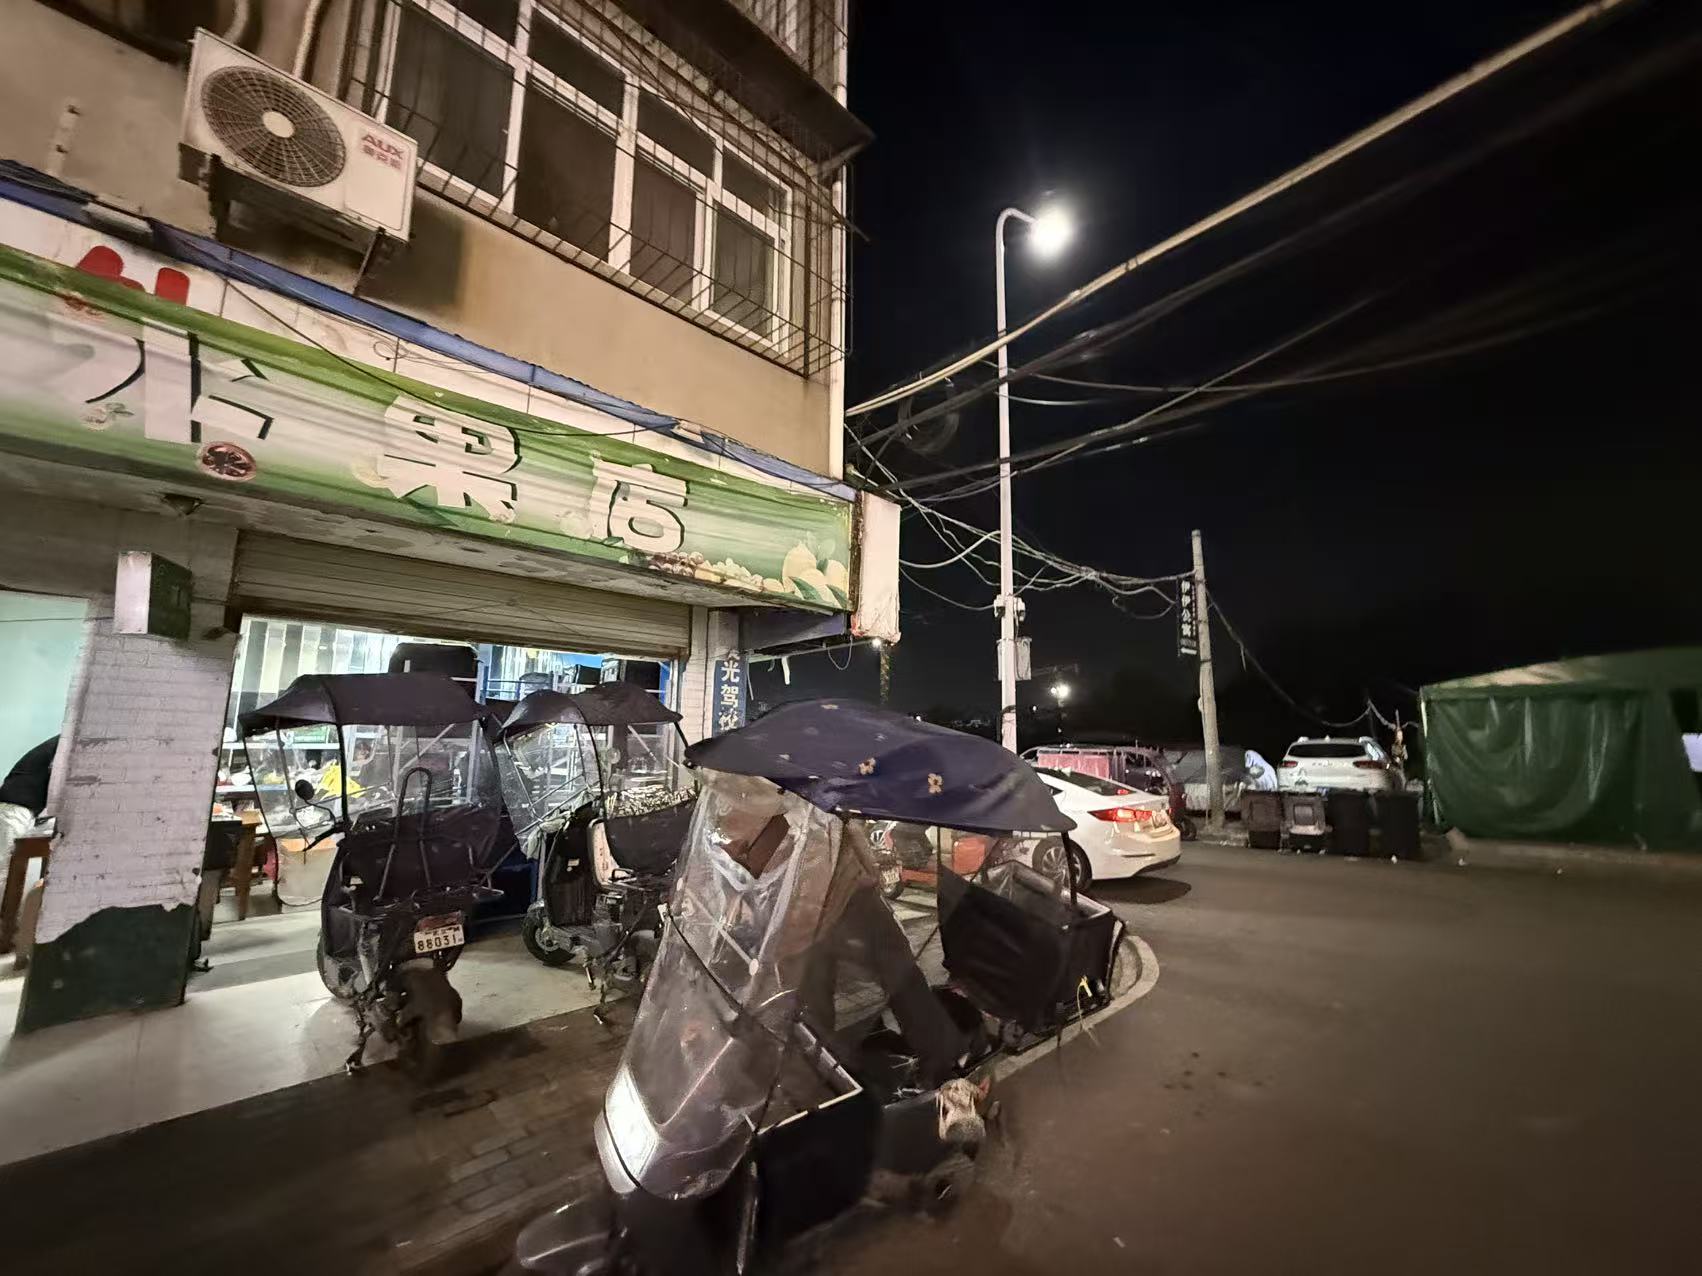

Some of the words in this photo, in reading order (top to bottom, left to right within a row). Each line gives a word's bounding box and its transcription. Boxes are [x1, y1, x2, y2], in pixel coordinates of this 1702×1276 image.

[361, 134, 404, 160] AUX
[45, 316, 690, 552] 水果店
